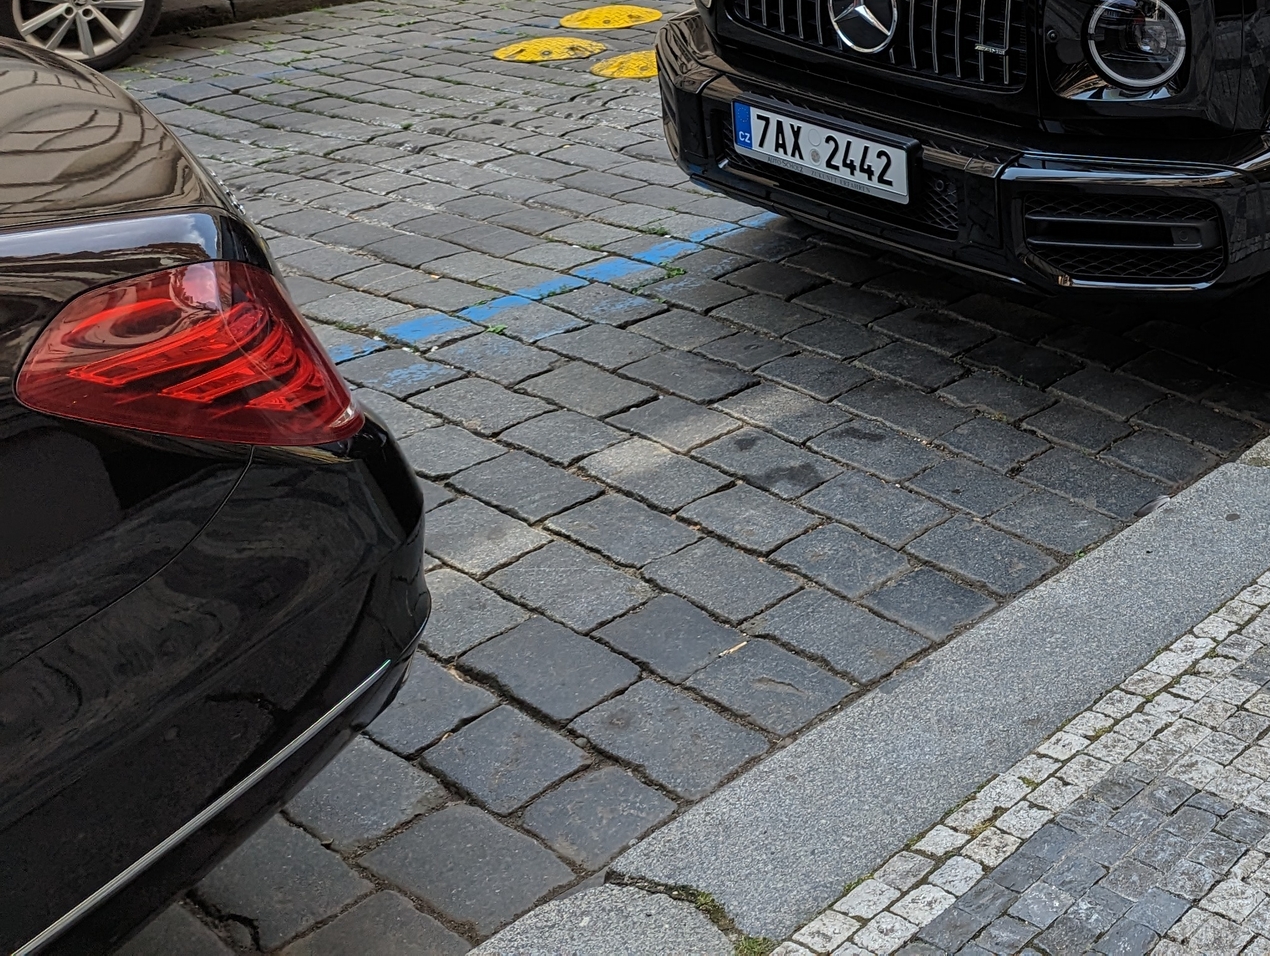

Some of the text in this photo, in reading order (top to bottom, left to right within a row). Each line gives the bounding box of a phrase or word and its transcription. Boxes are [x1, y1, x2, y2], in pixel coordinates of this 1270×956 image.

[739, 131, 750, 143] CZ
[756, 114, 893, 187] 7AX 2442
